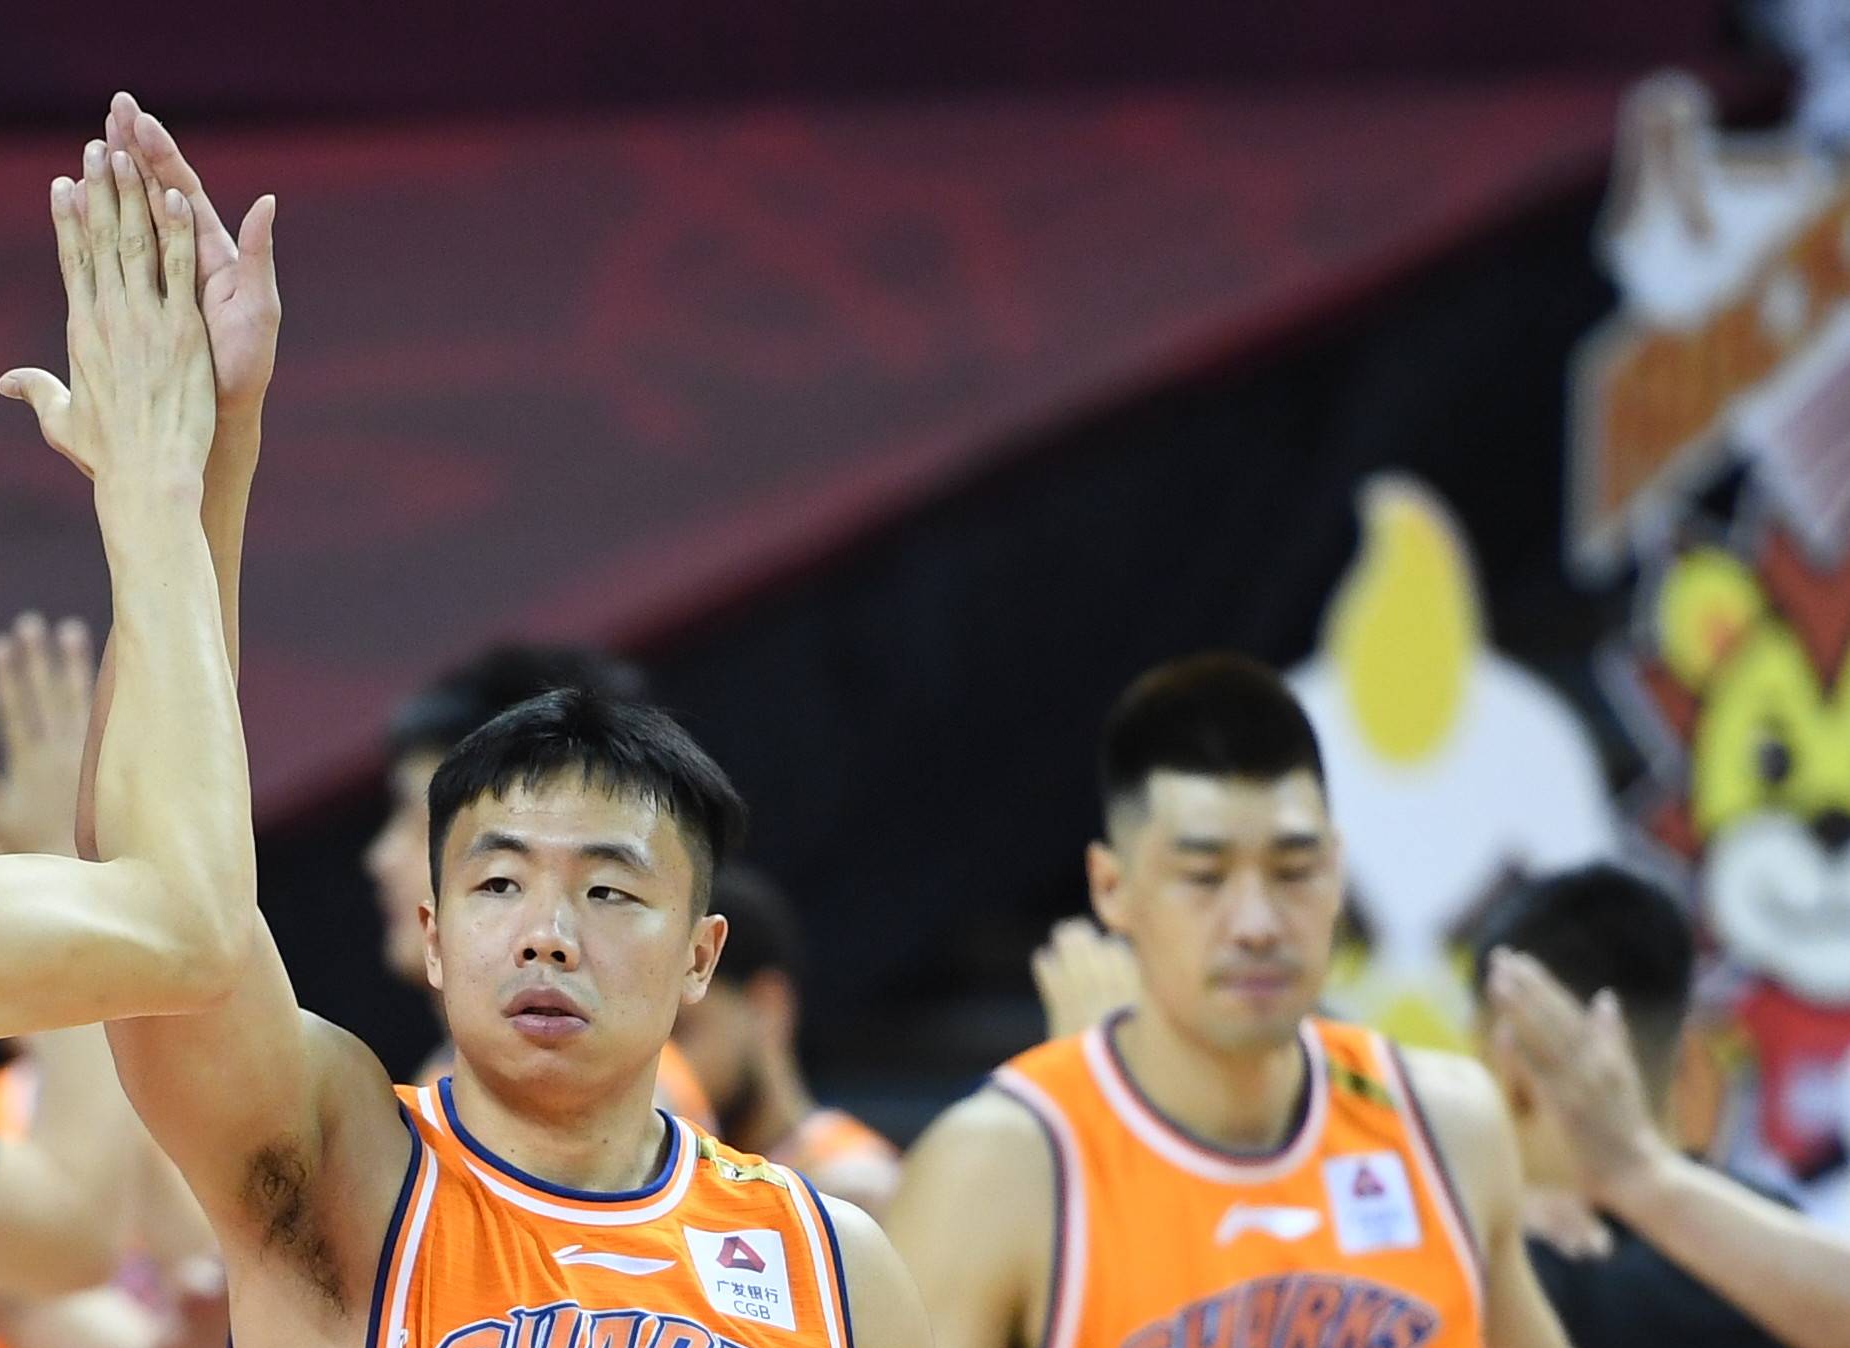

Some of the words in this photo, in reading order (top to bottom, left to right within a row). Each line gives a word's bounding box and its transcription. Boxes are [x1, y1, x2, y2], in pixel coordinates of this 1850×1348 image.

[716, 1280, 780, 1304] 广发银行
[733, 1300, 772, 1320] CGB
